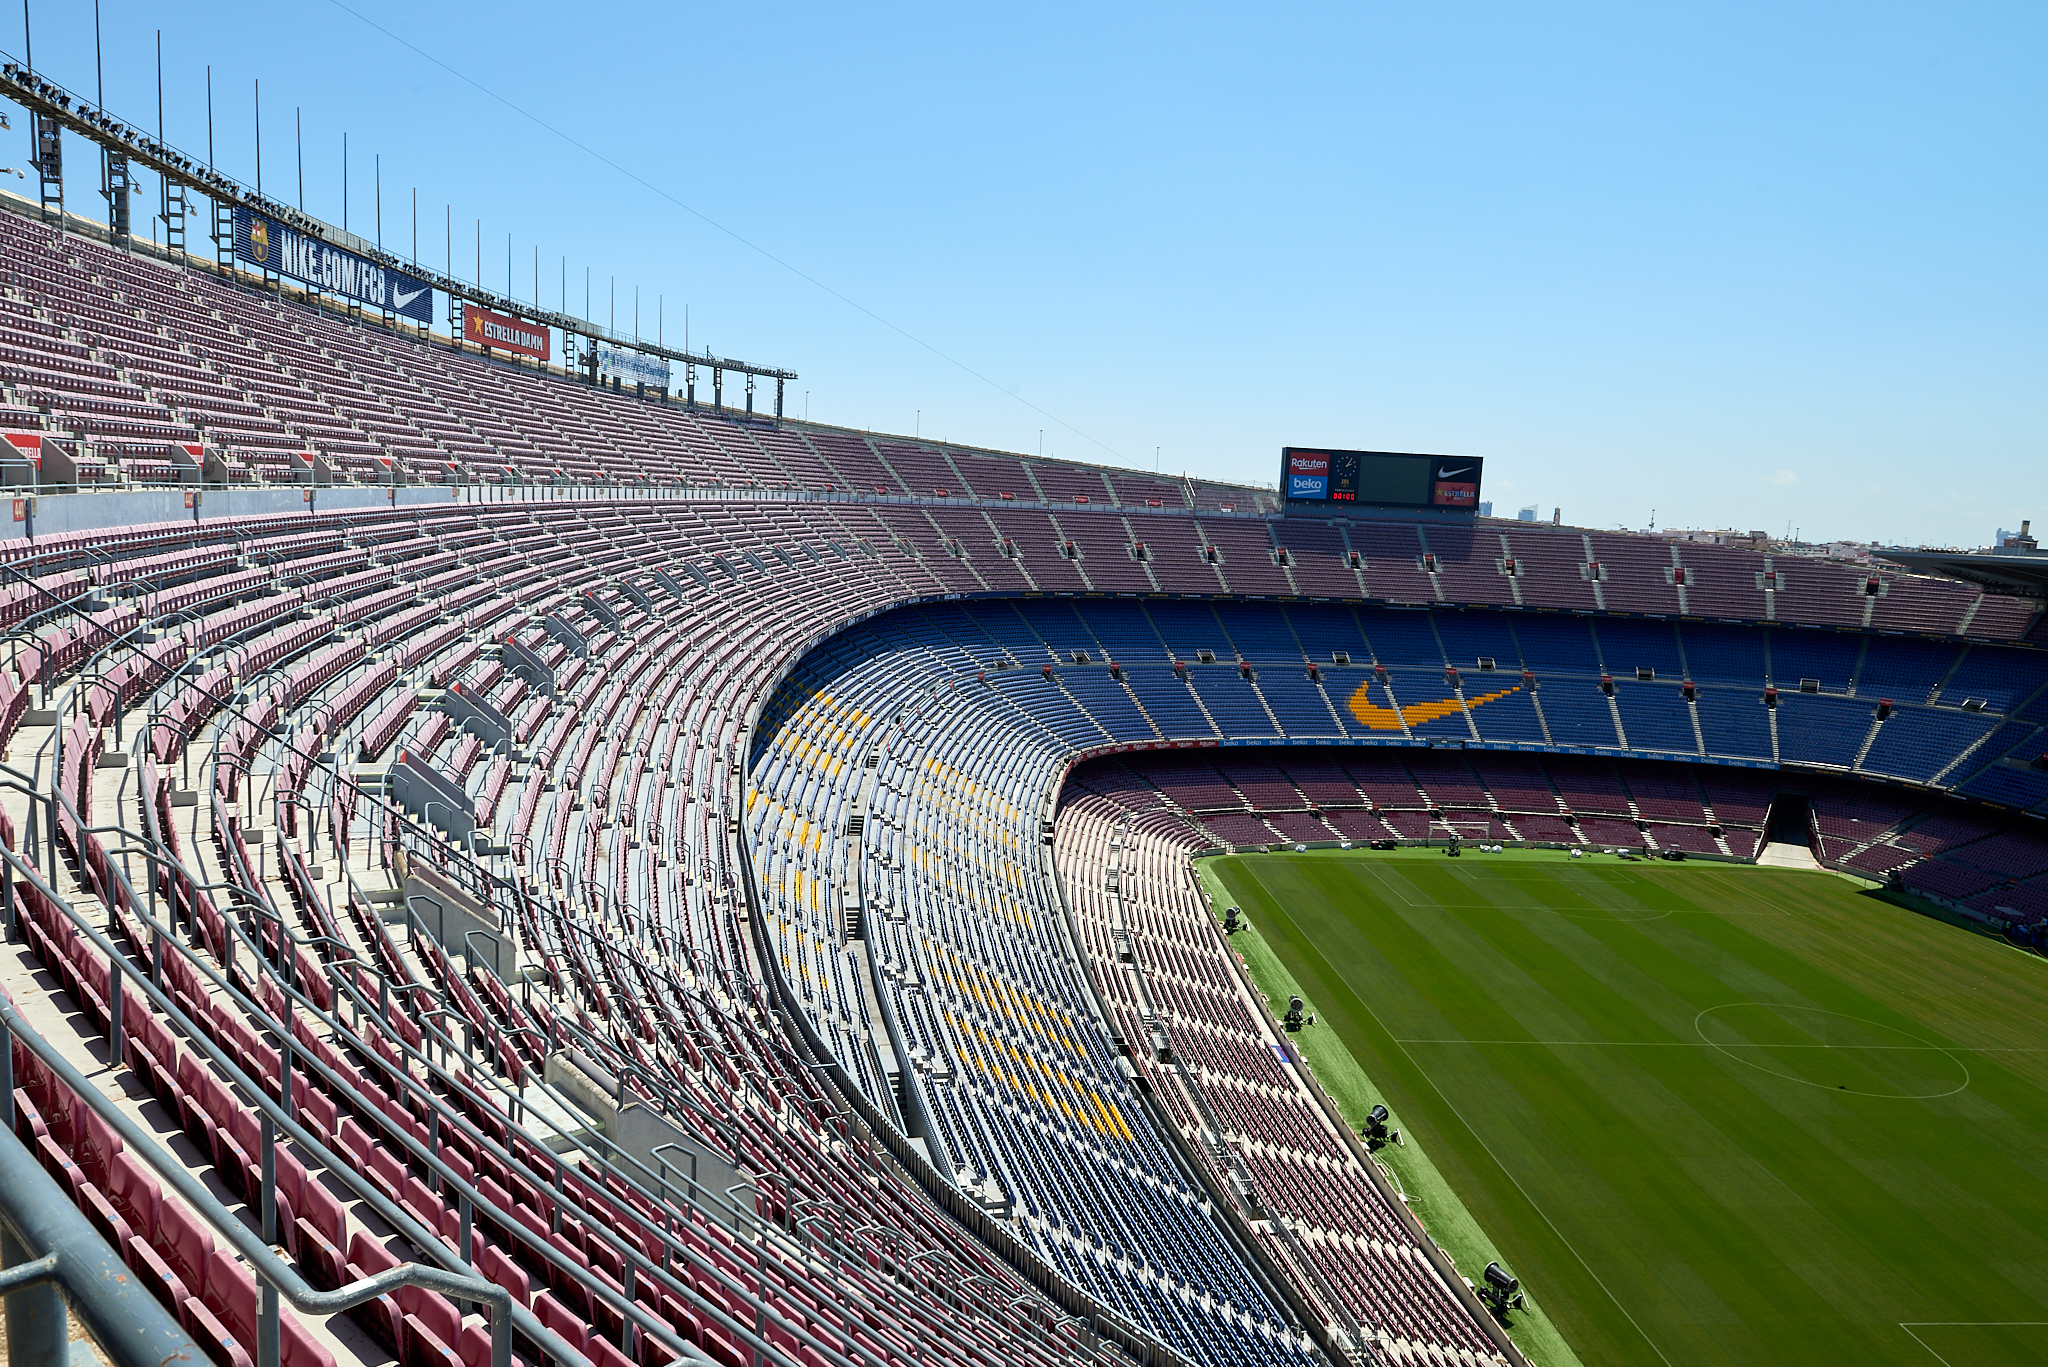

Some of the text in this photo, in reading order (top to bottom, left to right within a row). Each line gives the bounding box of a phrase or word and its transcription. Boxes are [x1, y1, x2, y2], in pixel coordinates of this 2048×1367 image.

[281, 229, 386, 305] NIKE.COM/FCB
[483, 319, 543, 352] ESTRELLA DAMM
[1291, 457, 1328, 469] Rakuten
[1293, 477, 1322, 489] beko
[1333, 492, 1355, 500] 00:00
[1444, 490, 1475, 498] ESTRELLA
